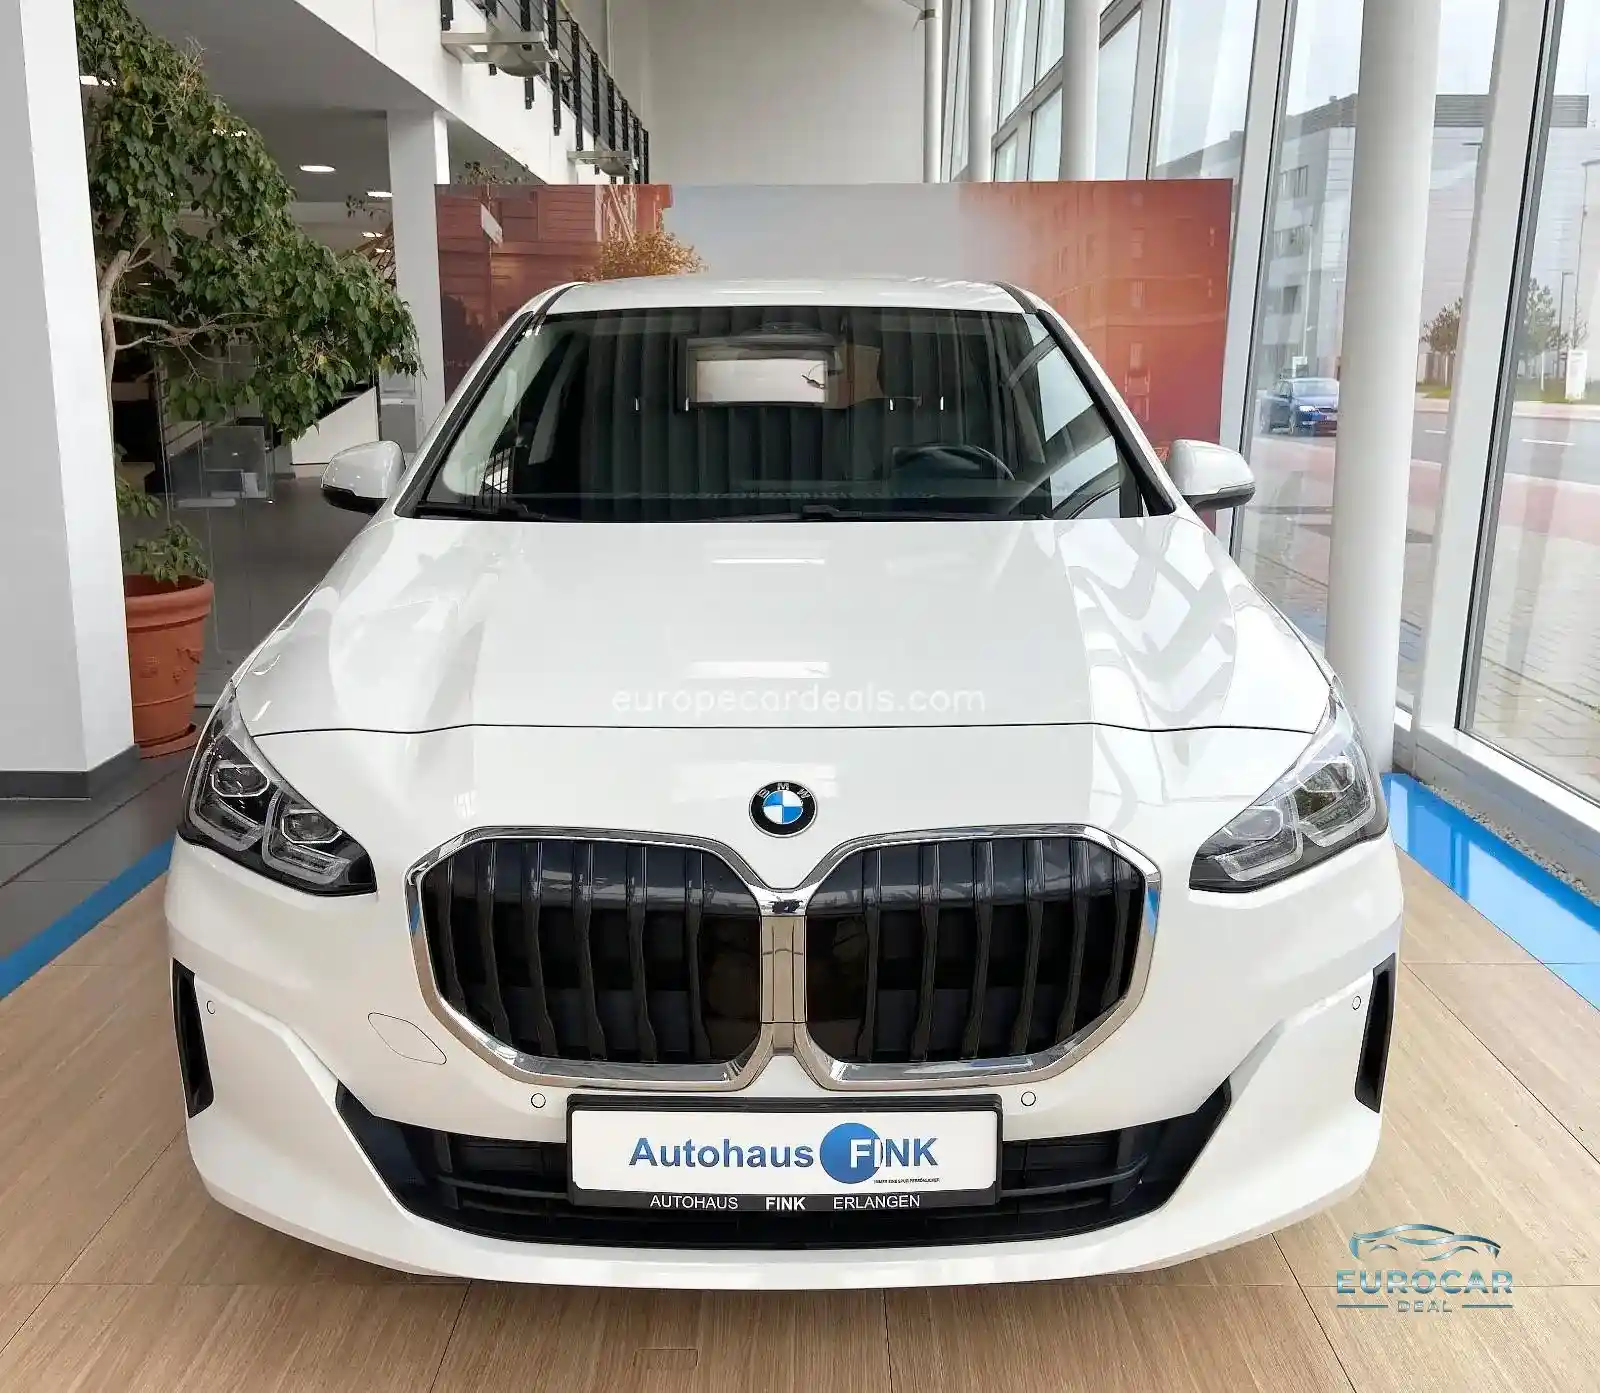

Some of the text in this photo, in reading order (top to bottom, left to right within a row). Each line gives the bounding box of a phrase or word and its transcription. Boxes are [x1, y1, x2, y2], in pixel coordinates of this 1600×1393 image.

[757, 782, 810, 799] BMW
[629, 1137, 938, 1168] Autohaus FINK
[650, 1194, 920, 1211] AUTOHAUS FINK ERLANGEN
